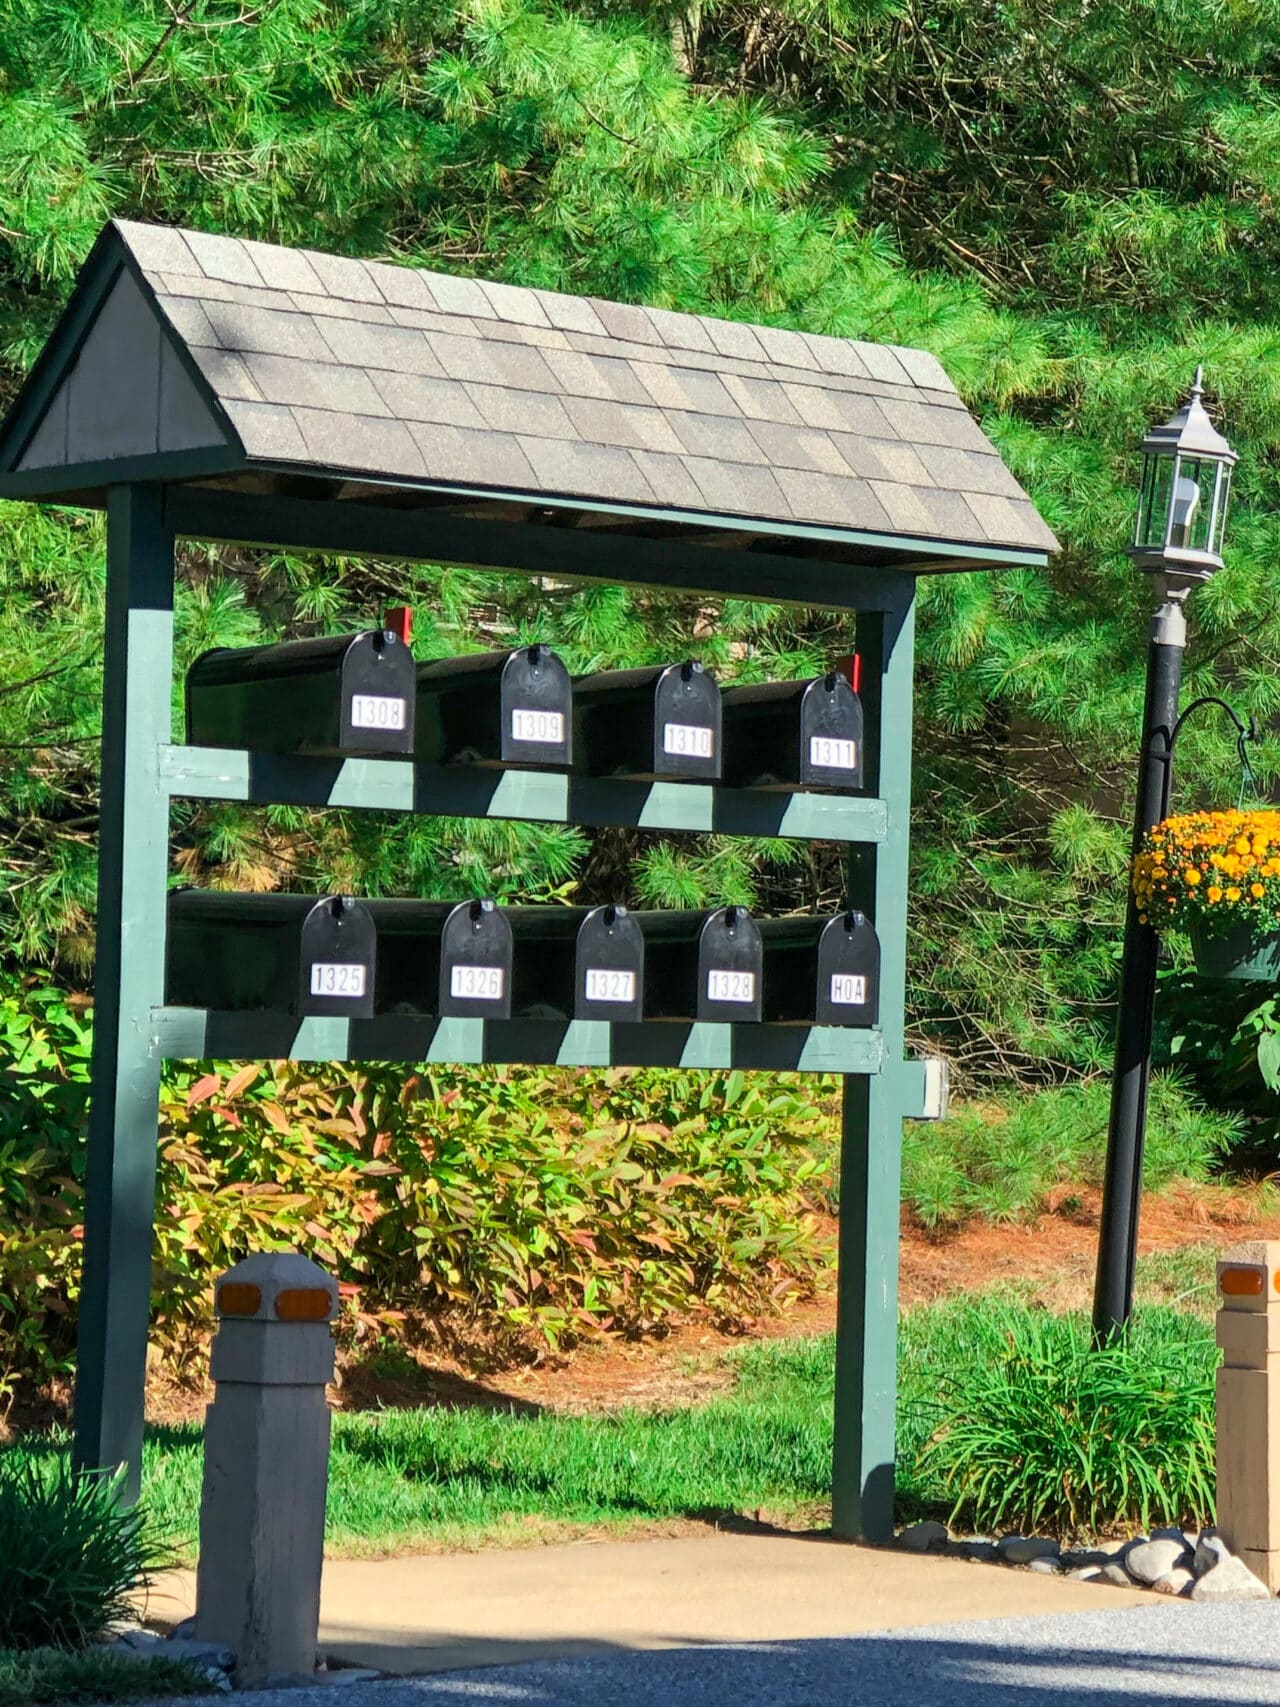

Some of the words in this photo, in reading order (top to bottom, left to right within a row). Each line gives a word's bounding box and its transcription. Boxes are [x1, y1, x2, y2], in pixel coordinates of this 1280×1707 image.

[356, 698, 400, 727] 1308
[516, 713, 560, 741] 1309
[668, 726, 710, 755] 1310
[814, 739, 852, 766] 1311
[315, 966, 361, 993] 1325
[456, 969, 499, 996] 1326
[590, 972, 631, 999] 1327
[711, 972, 751, 999] 1328
[833, 978, 863, 1001] HOA
